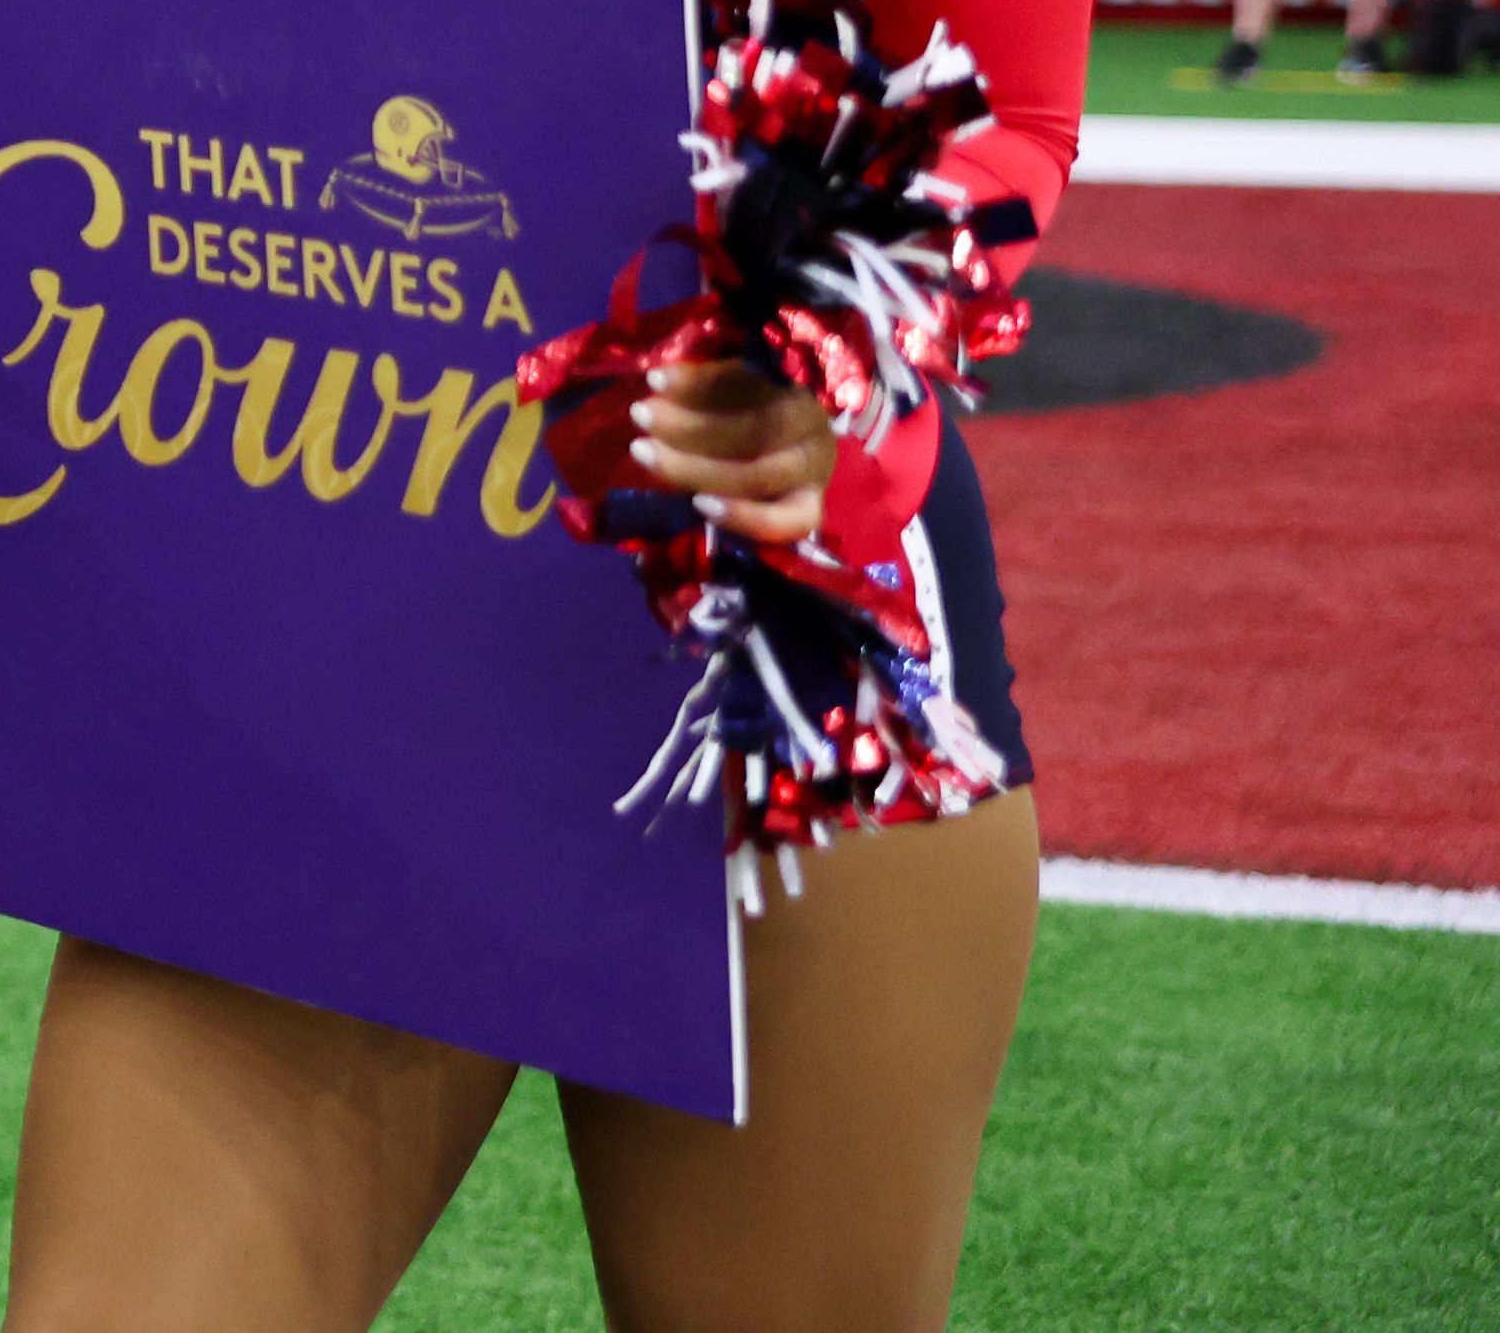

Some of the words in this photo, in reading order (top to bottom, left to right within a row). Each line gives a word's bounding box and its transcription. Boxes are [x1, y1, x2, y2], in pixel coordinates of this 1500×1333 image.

[139, 129, 304, 209] THAT
[148, 214, 464, 323] DESERVES
[482, 269, 534, 334] A
